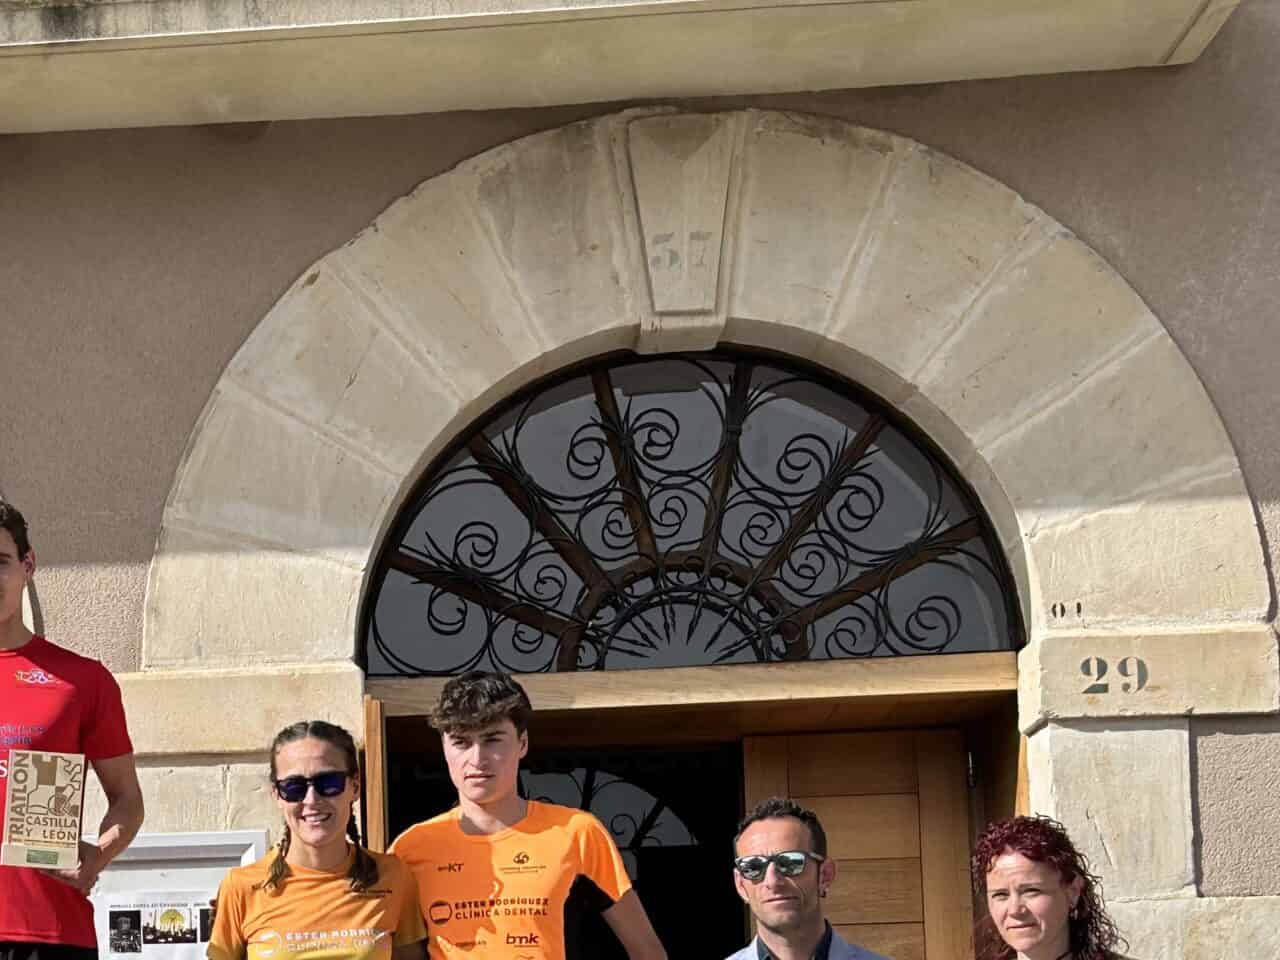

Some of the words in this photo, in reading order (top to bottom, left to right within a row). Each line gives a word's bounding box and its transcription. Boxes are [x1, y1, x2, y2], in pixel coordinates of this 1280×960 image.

[1080, 656, 1149, 694] 29
[8, 752, 29, 846] TRIATLON
[26, 816, 78, 828] CASTILLA
[26, 828, 33, 837] Y
[455, 900, 487, 910] ESTER
[504, 907, 548, 917] DENTAL
